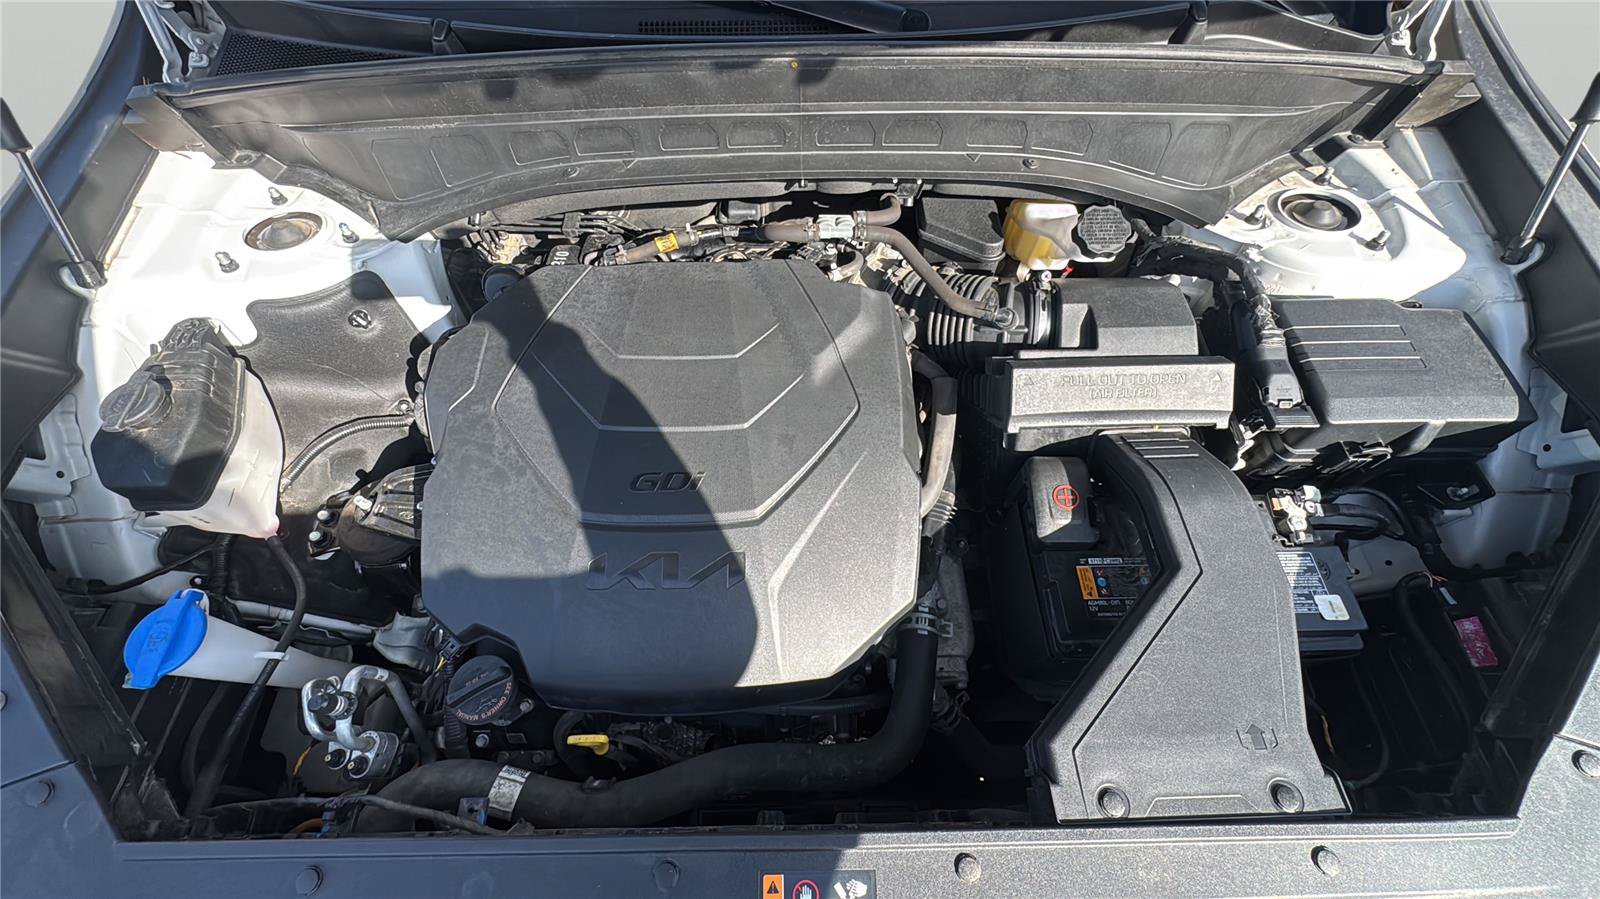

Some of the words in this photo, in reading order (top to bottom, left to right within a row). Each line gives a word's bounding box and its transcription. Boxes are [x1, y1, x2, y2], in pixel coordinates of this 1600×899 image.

[1062, 374, 1093, 387] PULL
[1099, 373, 1125, 386] OUT
[1130, 373, 1150, 386] TO
[1151, 372, 1187, 385] OPEN
[629, 471, 707, 494] GDi
[586, 551, 746, 591] KIA
[504, 682, 512, 695] SEE
[456, 709, 479, 721] MANUAL
